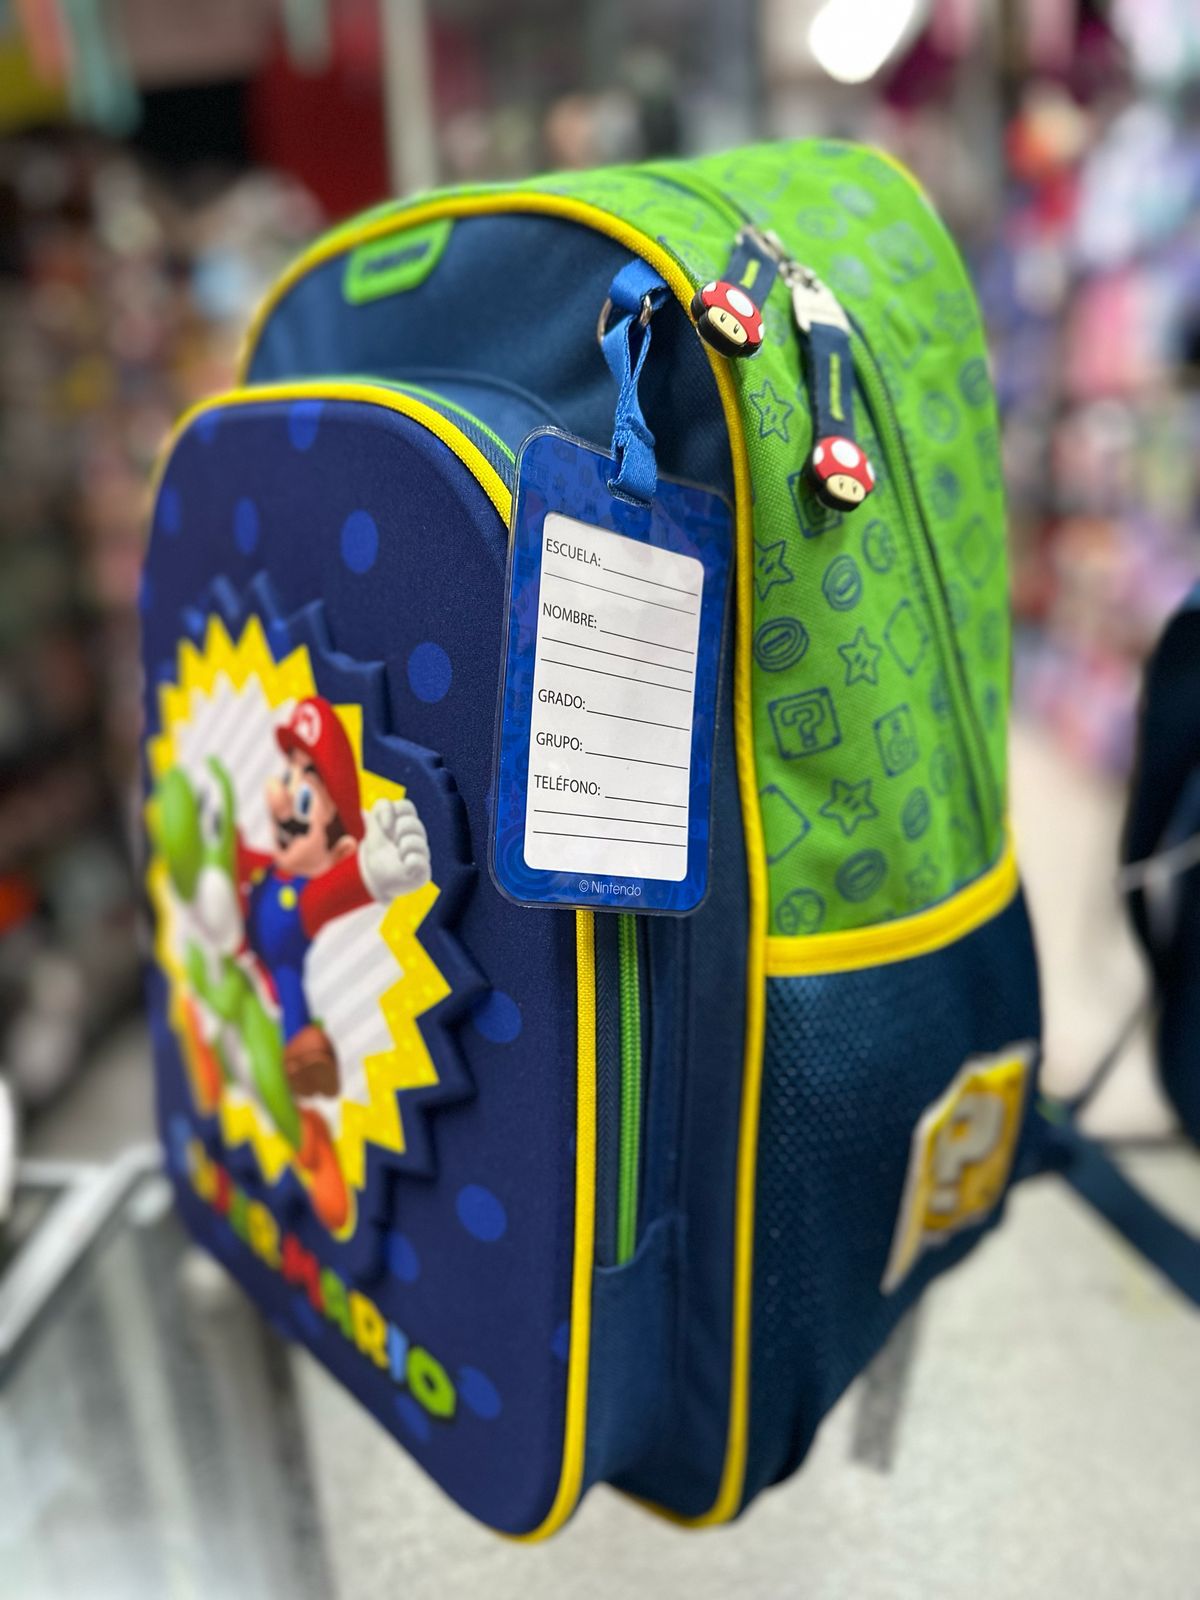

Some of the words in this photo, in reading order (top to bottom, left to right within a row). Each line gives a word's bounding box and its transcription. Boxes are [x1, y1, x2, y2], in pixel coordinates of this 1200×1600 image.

[546, 538, 601, 567] ESCUELA:
[542, 602, 598, 629] NOMBRE:
[538, 688, 586, 710] GRADO:
[536, 731, 583, 752] GRUPO:
[533, 774, 601, 796] TELÉFONO:
[591, 880, 642, 897] Nintendo
